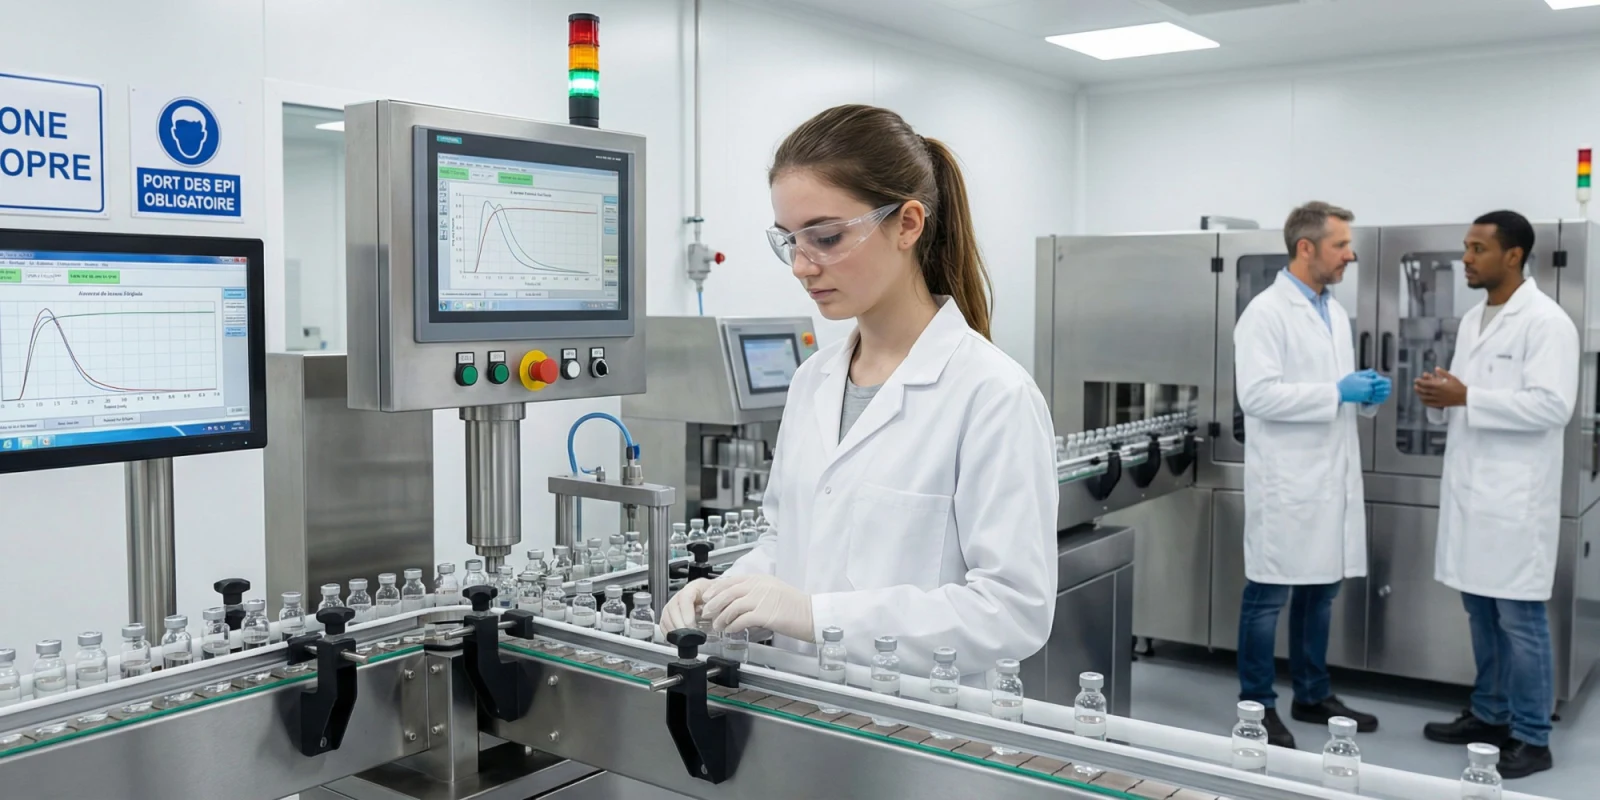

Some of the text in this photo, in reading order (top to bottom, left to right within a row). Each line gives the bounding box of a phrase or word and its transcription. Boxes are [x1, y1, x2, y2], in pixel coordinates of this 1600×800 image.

[0, 106, 68, 139] ONE
[0, 148, 92, 181] OPRE
[143, 174, 235, 193] PORT DES EPI
[144, 192, 235, 211] OBLIGATOIRE
